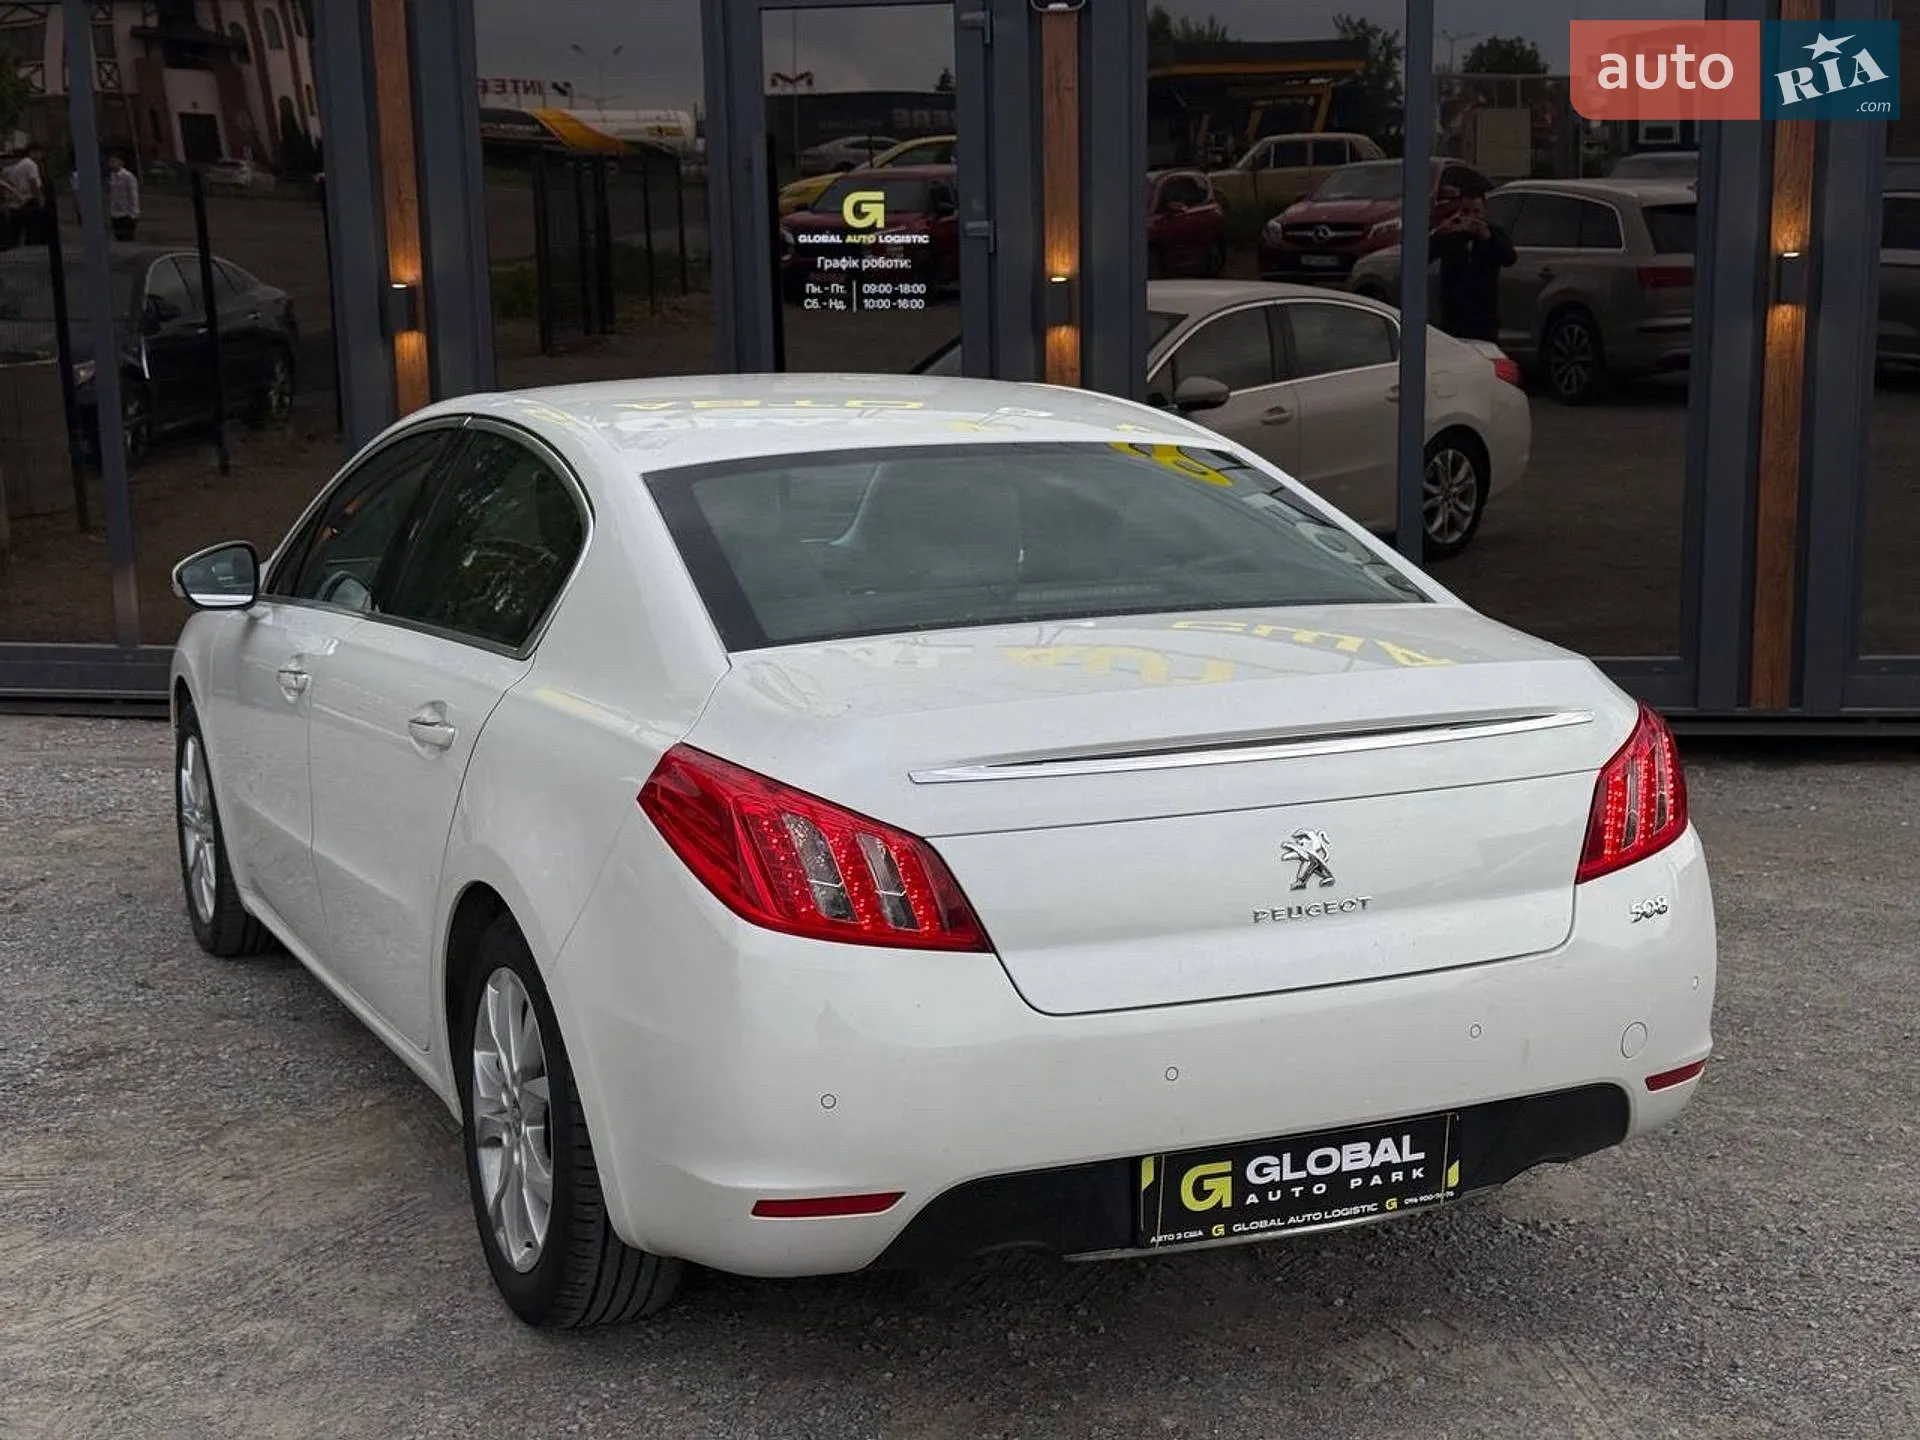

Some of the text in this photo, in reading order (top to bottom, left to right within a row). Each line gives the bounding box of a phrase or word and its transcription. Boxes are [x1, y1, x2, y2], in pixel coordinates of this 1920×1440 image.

[798, 234, 930, 243] GLOBAL AUTO LOGISTIC
[817, 256, 912, 271] Графік роботи:
[1252, 896, 1373, 923] PEUGEOT
[1630, 896, 1669, 923] 508
[1246, 1134, 1426, 1185] GLOBAL
[1245, 1167, 1425, 1205] AUTO PARK
[1232, 1218, 1285, 1233] GLOBAL
[1287, 1212, 1322, 1225] AUTO
[1324, 1203, 1379, 1218] LOGISTIC
